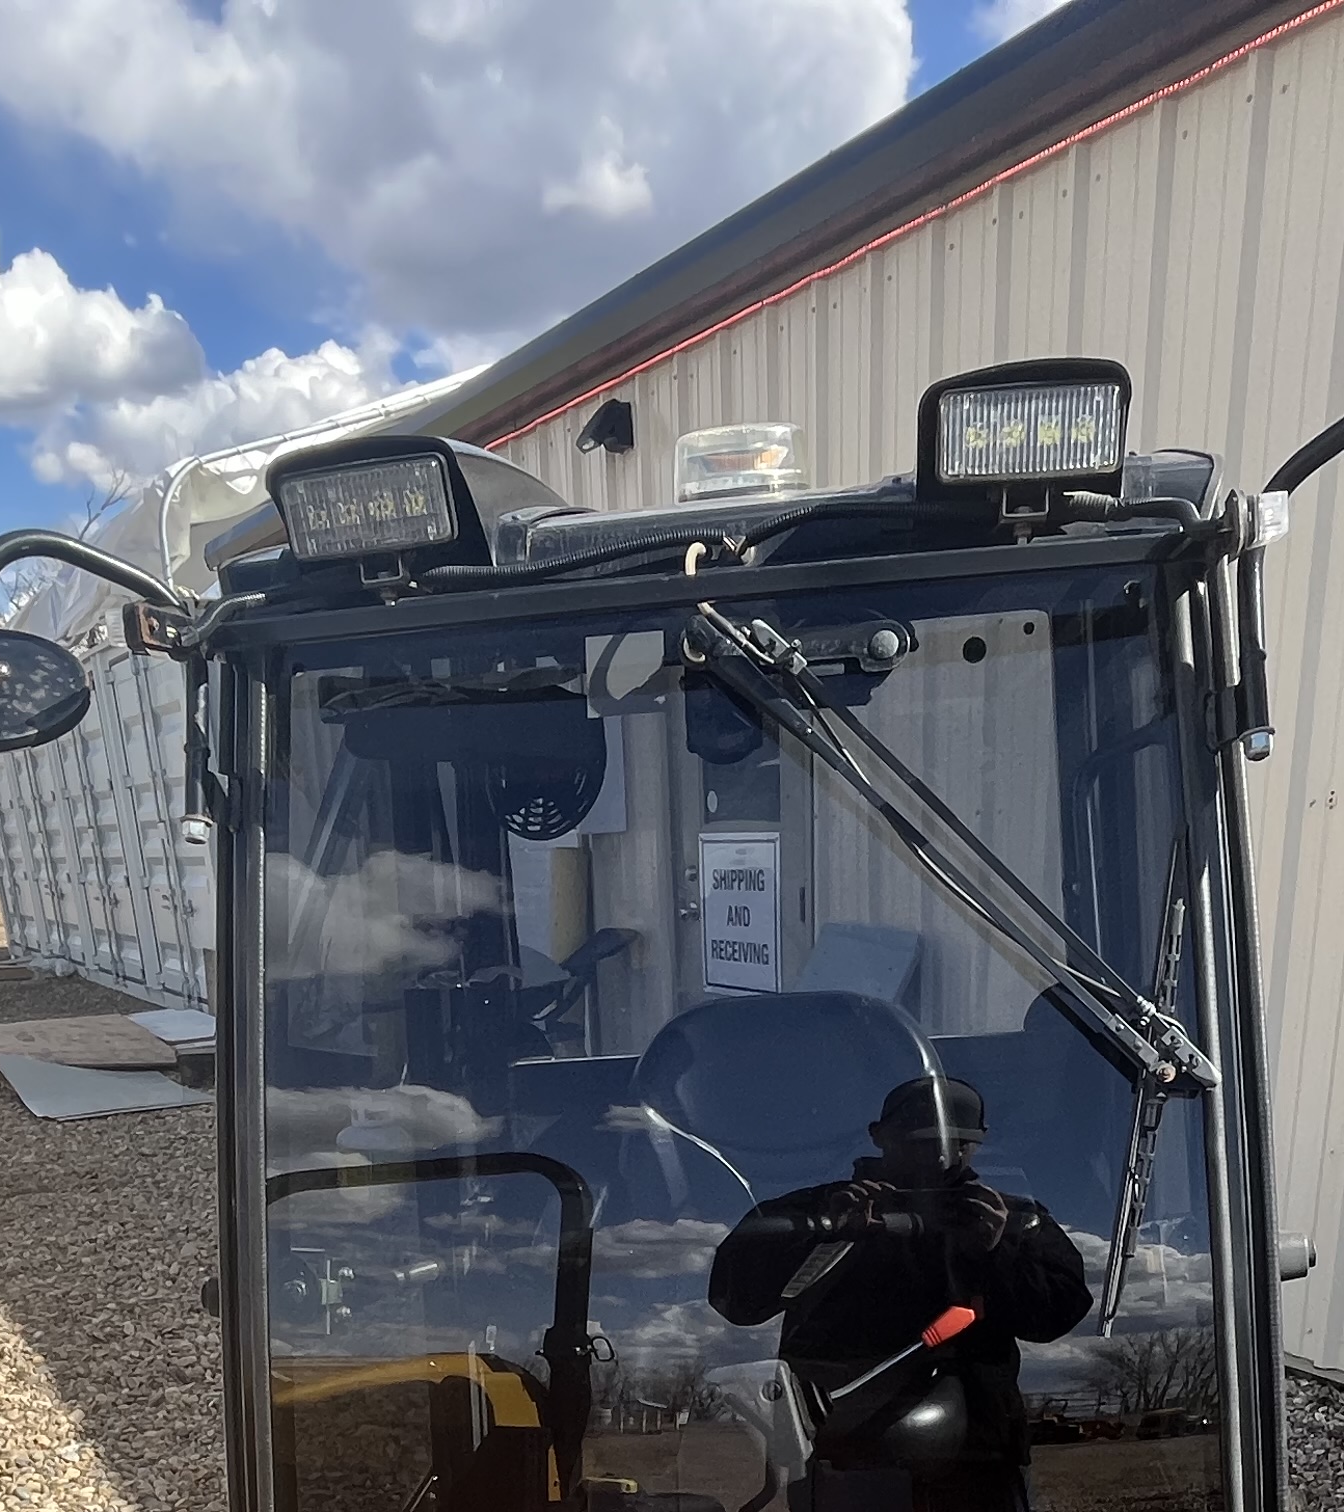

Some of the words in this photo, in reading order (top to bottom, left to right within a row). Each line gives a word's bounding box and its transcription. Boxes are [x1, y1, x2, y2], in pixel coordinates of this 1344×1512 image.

[712, 868, 765, 892] SHIPPING
[726, 905, 751, 928] AND
[710, 939, 770, 965] RECEIVING
